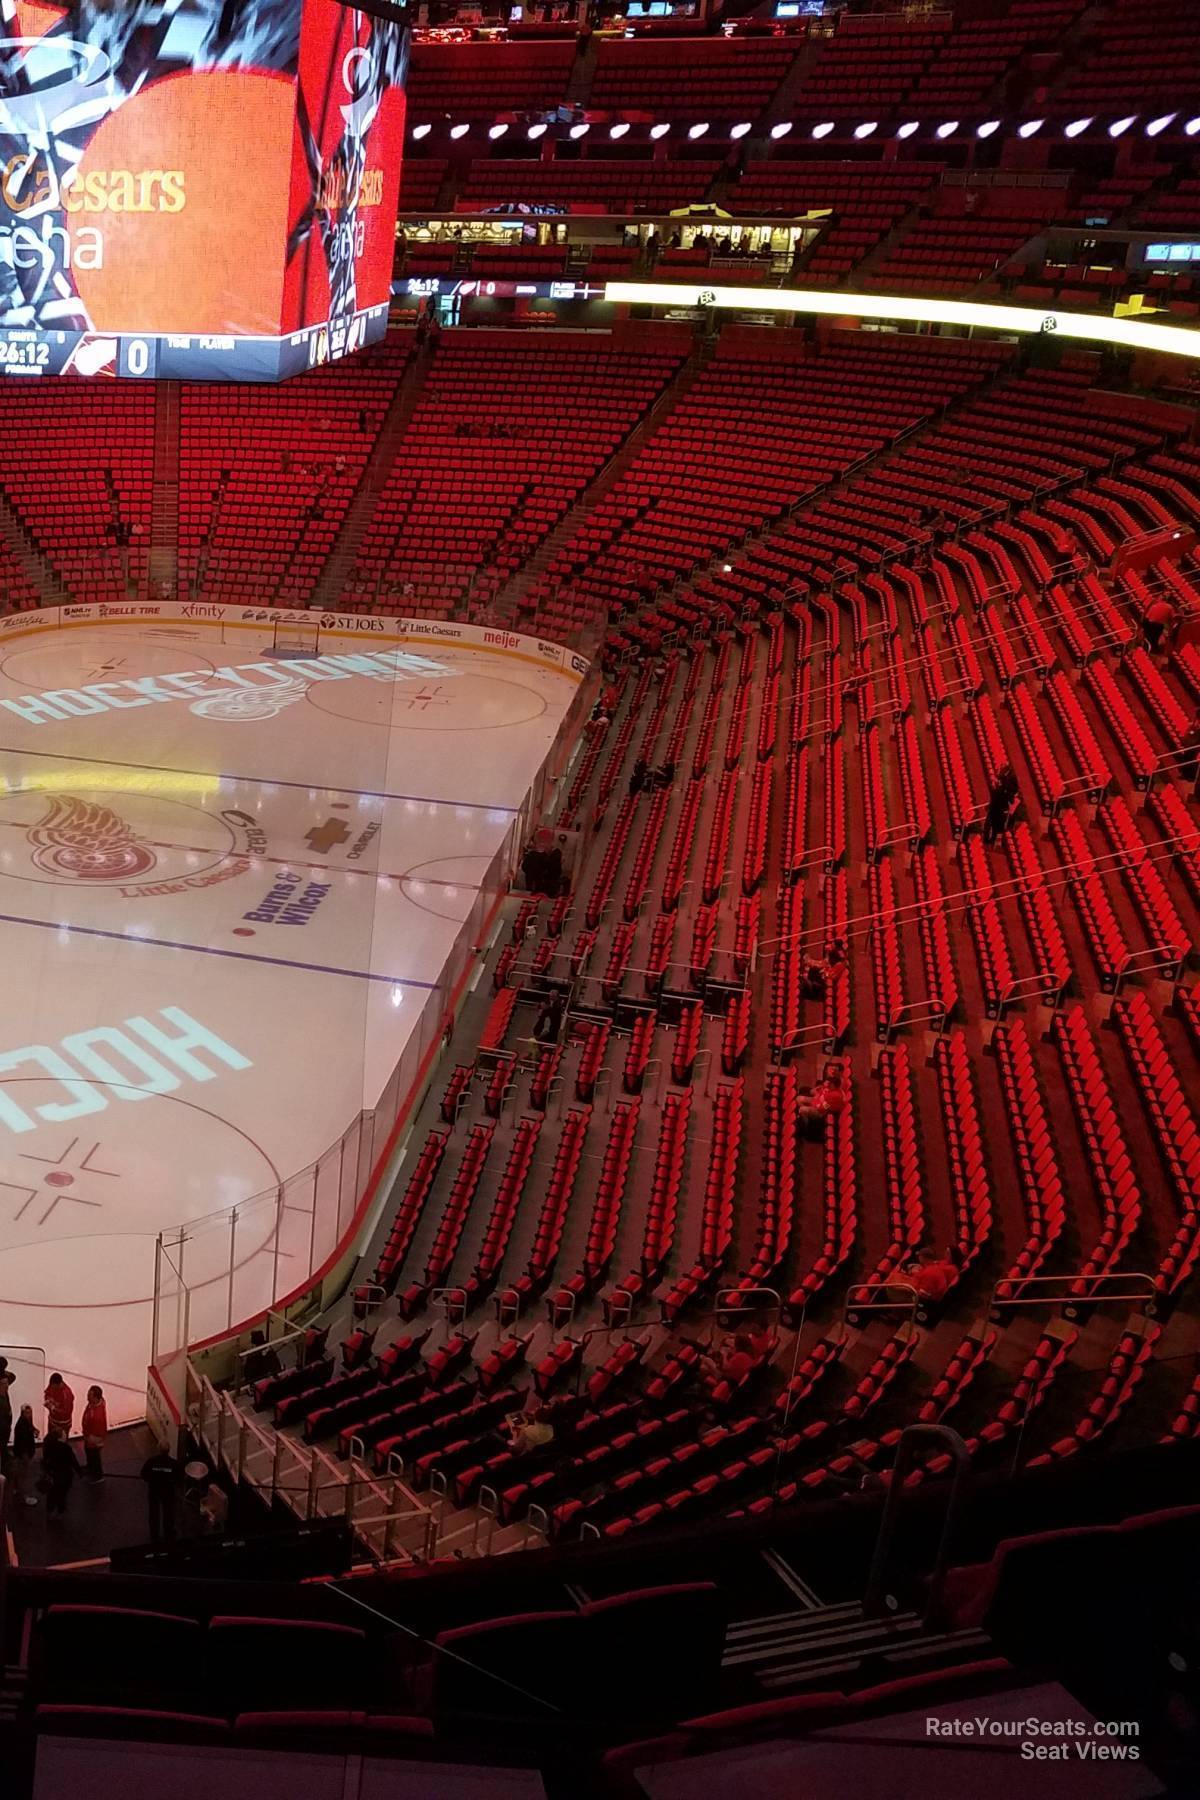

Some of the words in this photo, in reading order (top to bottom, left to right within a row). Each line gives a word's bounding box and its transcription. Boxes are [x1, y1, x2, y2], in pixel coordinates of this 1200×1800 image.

[3, 153, 186, 213] Caesars
[128, 340, 148, 374] 0
[108, 607, 136, 615] BELLE
[181, 603, 226, 620] xfinity
[337, 618, 354, 628] ST.
[354, 618, 385, 631] JOE'S
[410, 623, 432, 634] Little
[431, 626, 462, 637] Caesars
[484, 632, 521, 648] meijer
[118, 884, 188, 898] Little
[242, 883, 297, 923] Burns
[275, 881, 333, 926] Wilcox
